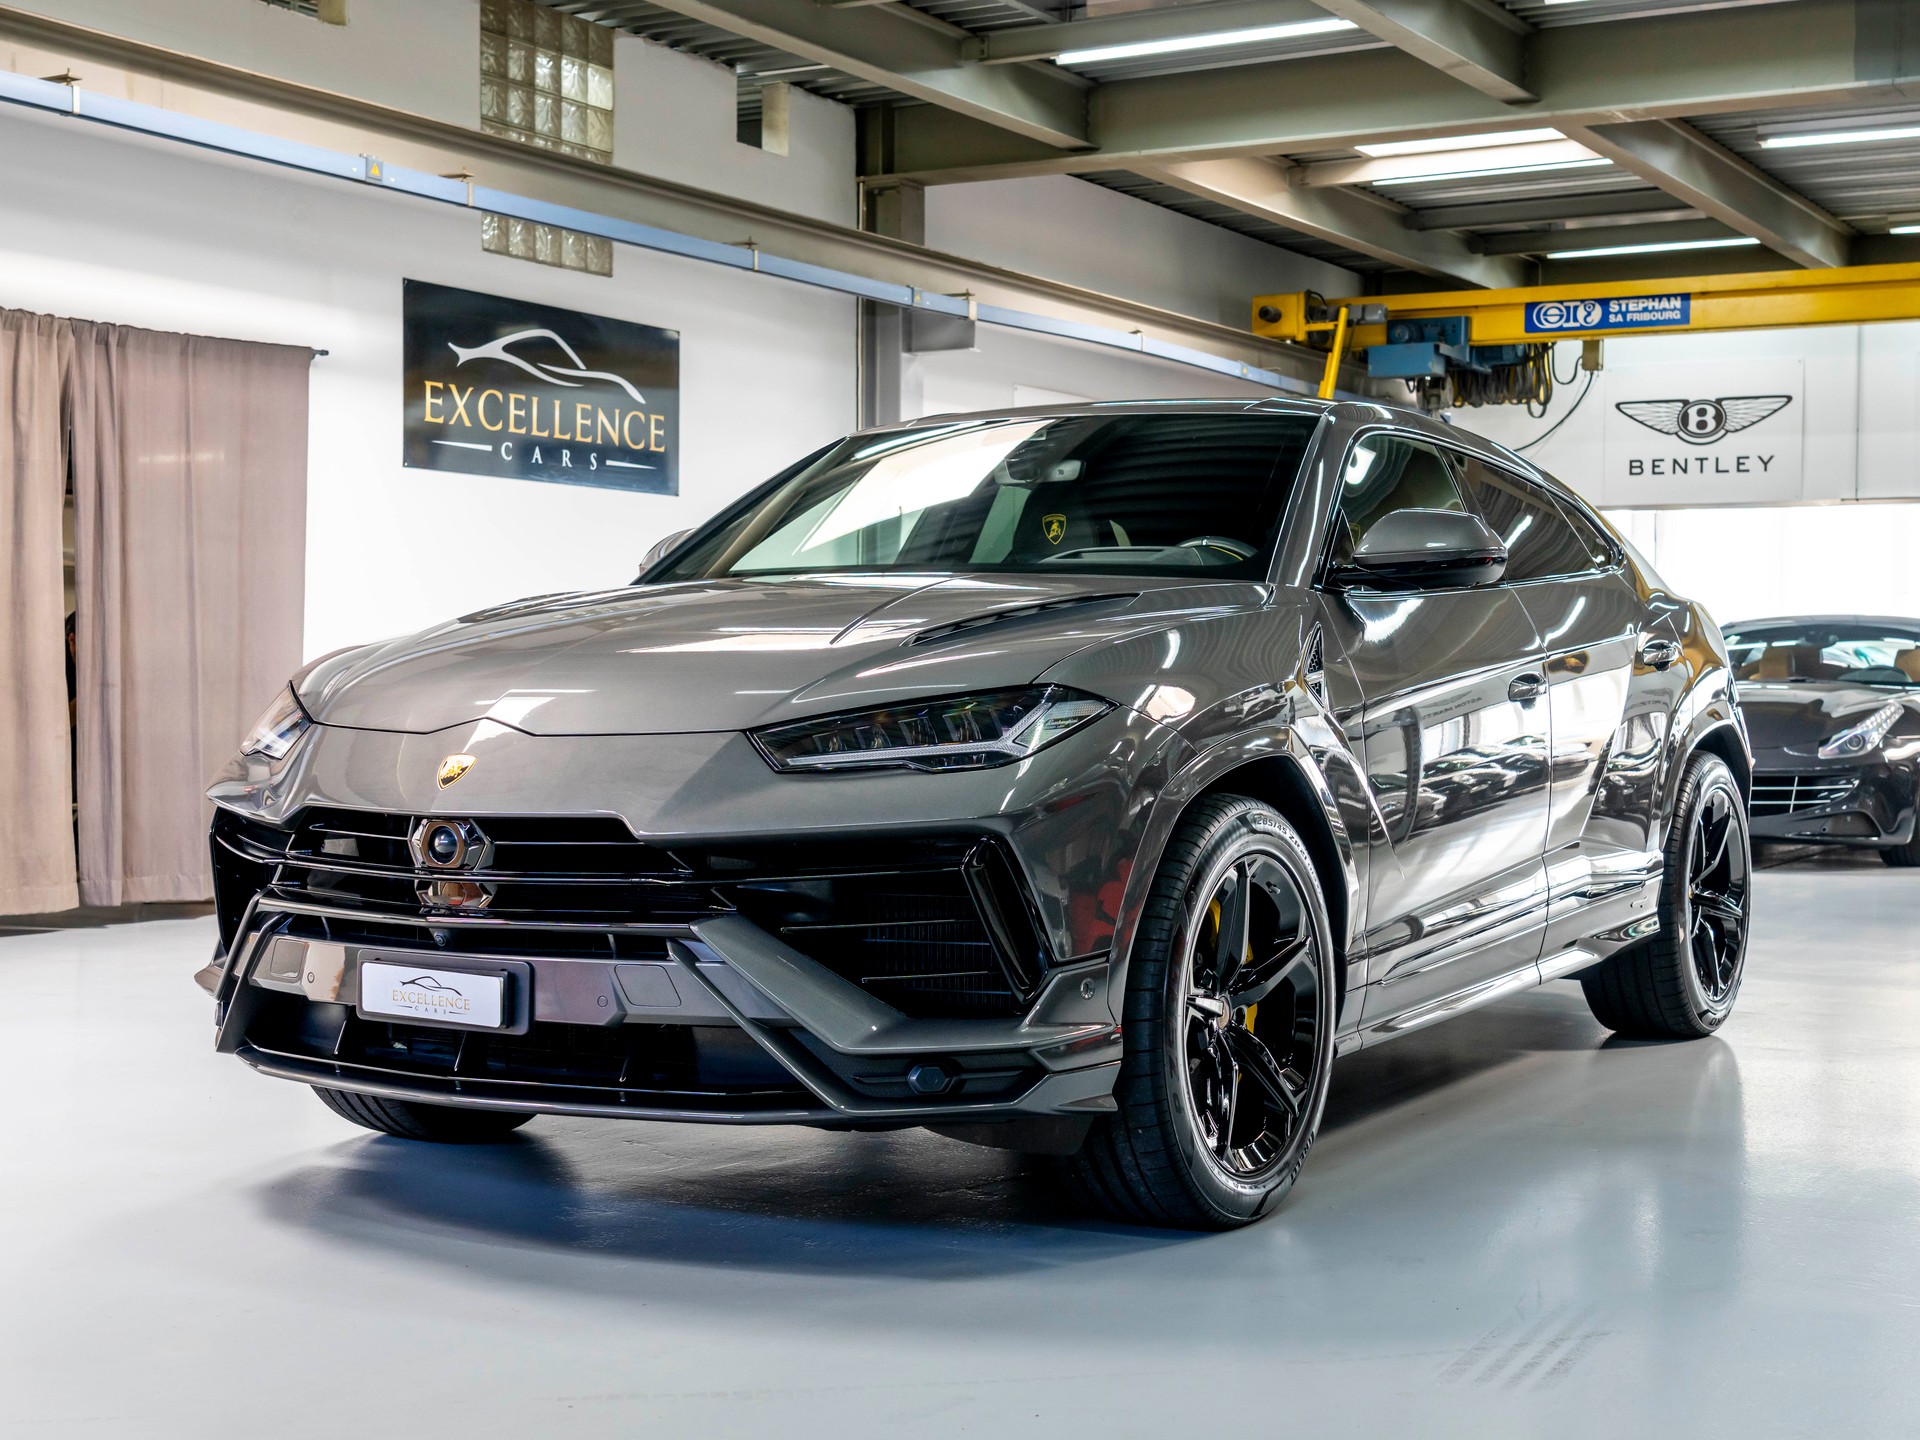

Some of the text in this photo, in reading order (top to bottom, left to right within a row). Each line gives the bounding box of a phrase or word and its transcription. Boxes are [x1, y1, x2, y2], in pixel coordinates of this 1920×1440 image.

[1609, 296, 1681, 313] STEPHAN
[1609, 313, 1624, 323] SA
[1626, 304, 1681, 322] FRIBOURG
[423, 380, 666, 453] EXCELLENCE
[500, 442, 598, 470] CARS
[1629, 455, 1775, 476] BENTLEY
[392, 990, 470, 1010] EXCELLENCE
[415, 1006, 446, 1014] CARS
